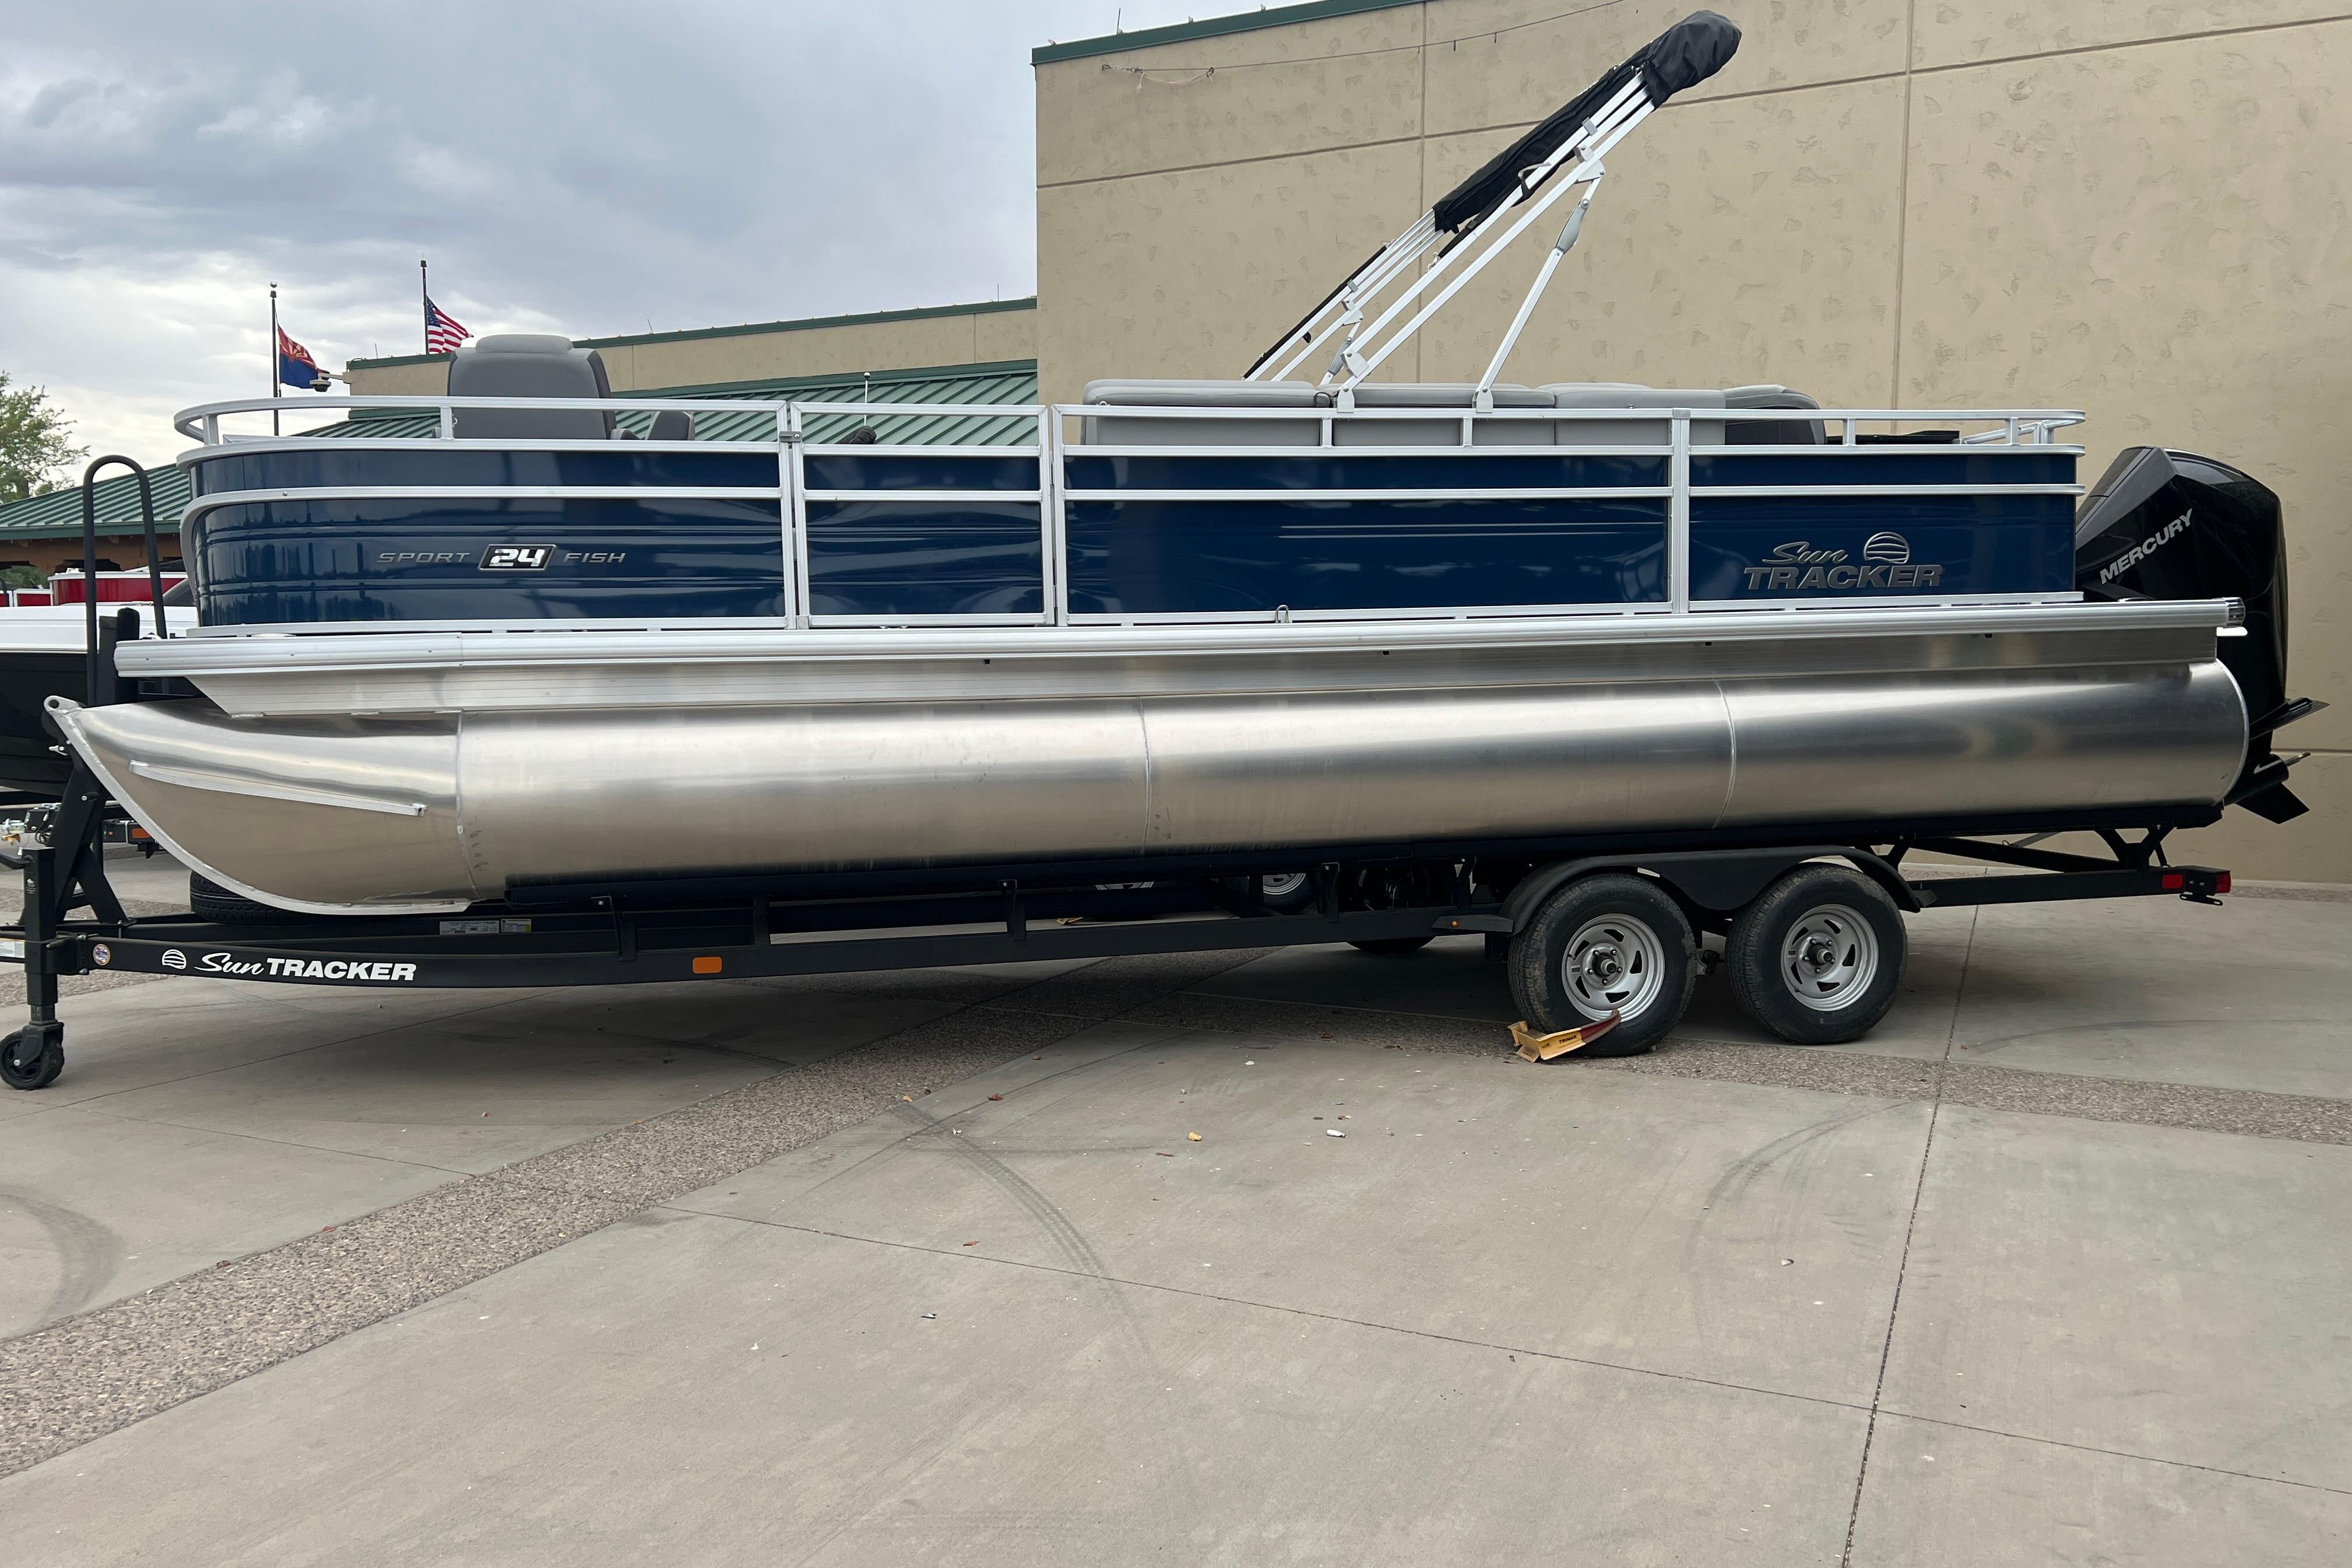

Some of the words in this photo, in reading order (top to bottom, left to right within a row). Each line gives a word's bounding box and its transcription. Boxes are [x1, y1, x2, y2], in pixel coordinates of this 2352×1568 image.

[377, 552, 471, 564] SPORT
[489, 548, 545, 566] 24
[564, 552, 626, 564] FISH
[1762, 541, 1849, 565] Sun
[2100, 508, 2193, 584] MERCURY
[1744, 564, 1944, 590] TRACKER
[194, 952, 265, 976] Sun
[266, 957, 416, 981] TRACKER
[1559, 1034, 1577, 1044] TRIMAX
